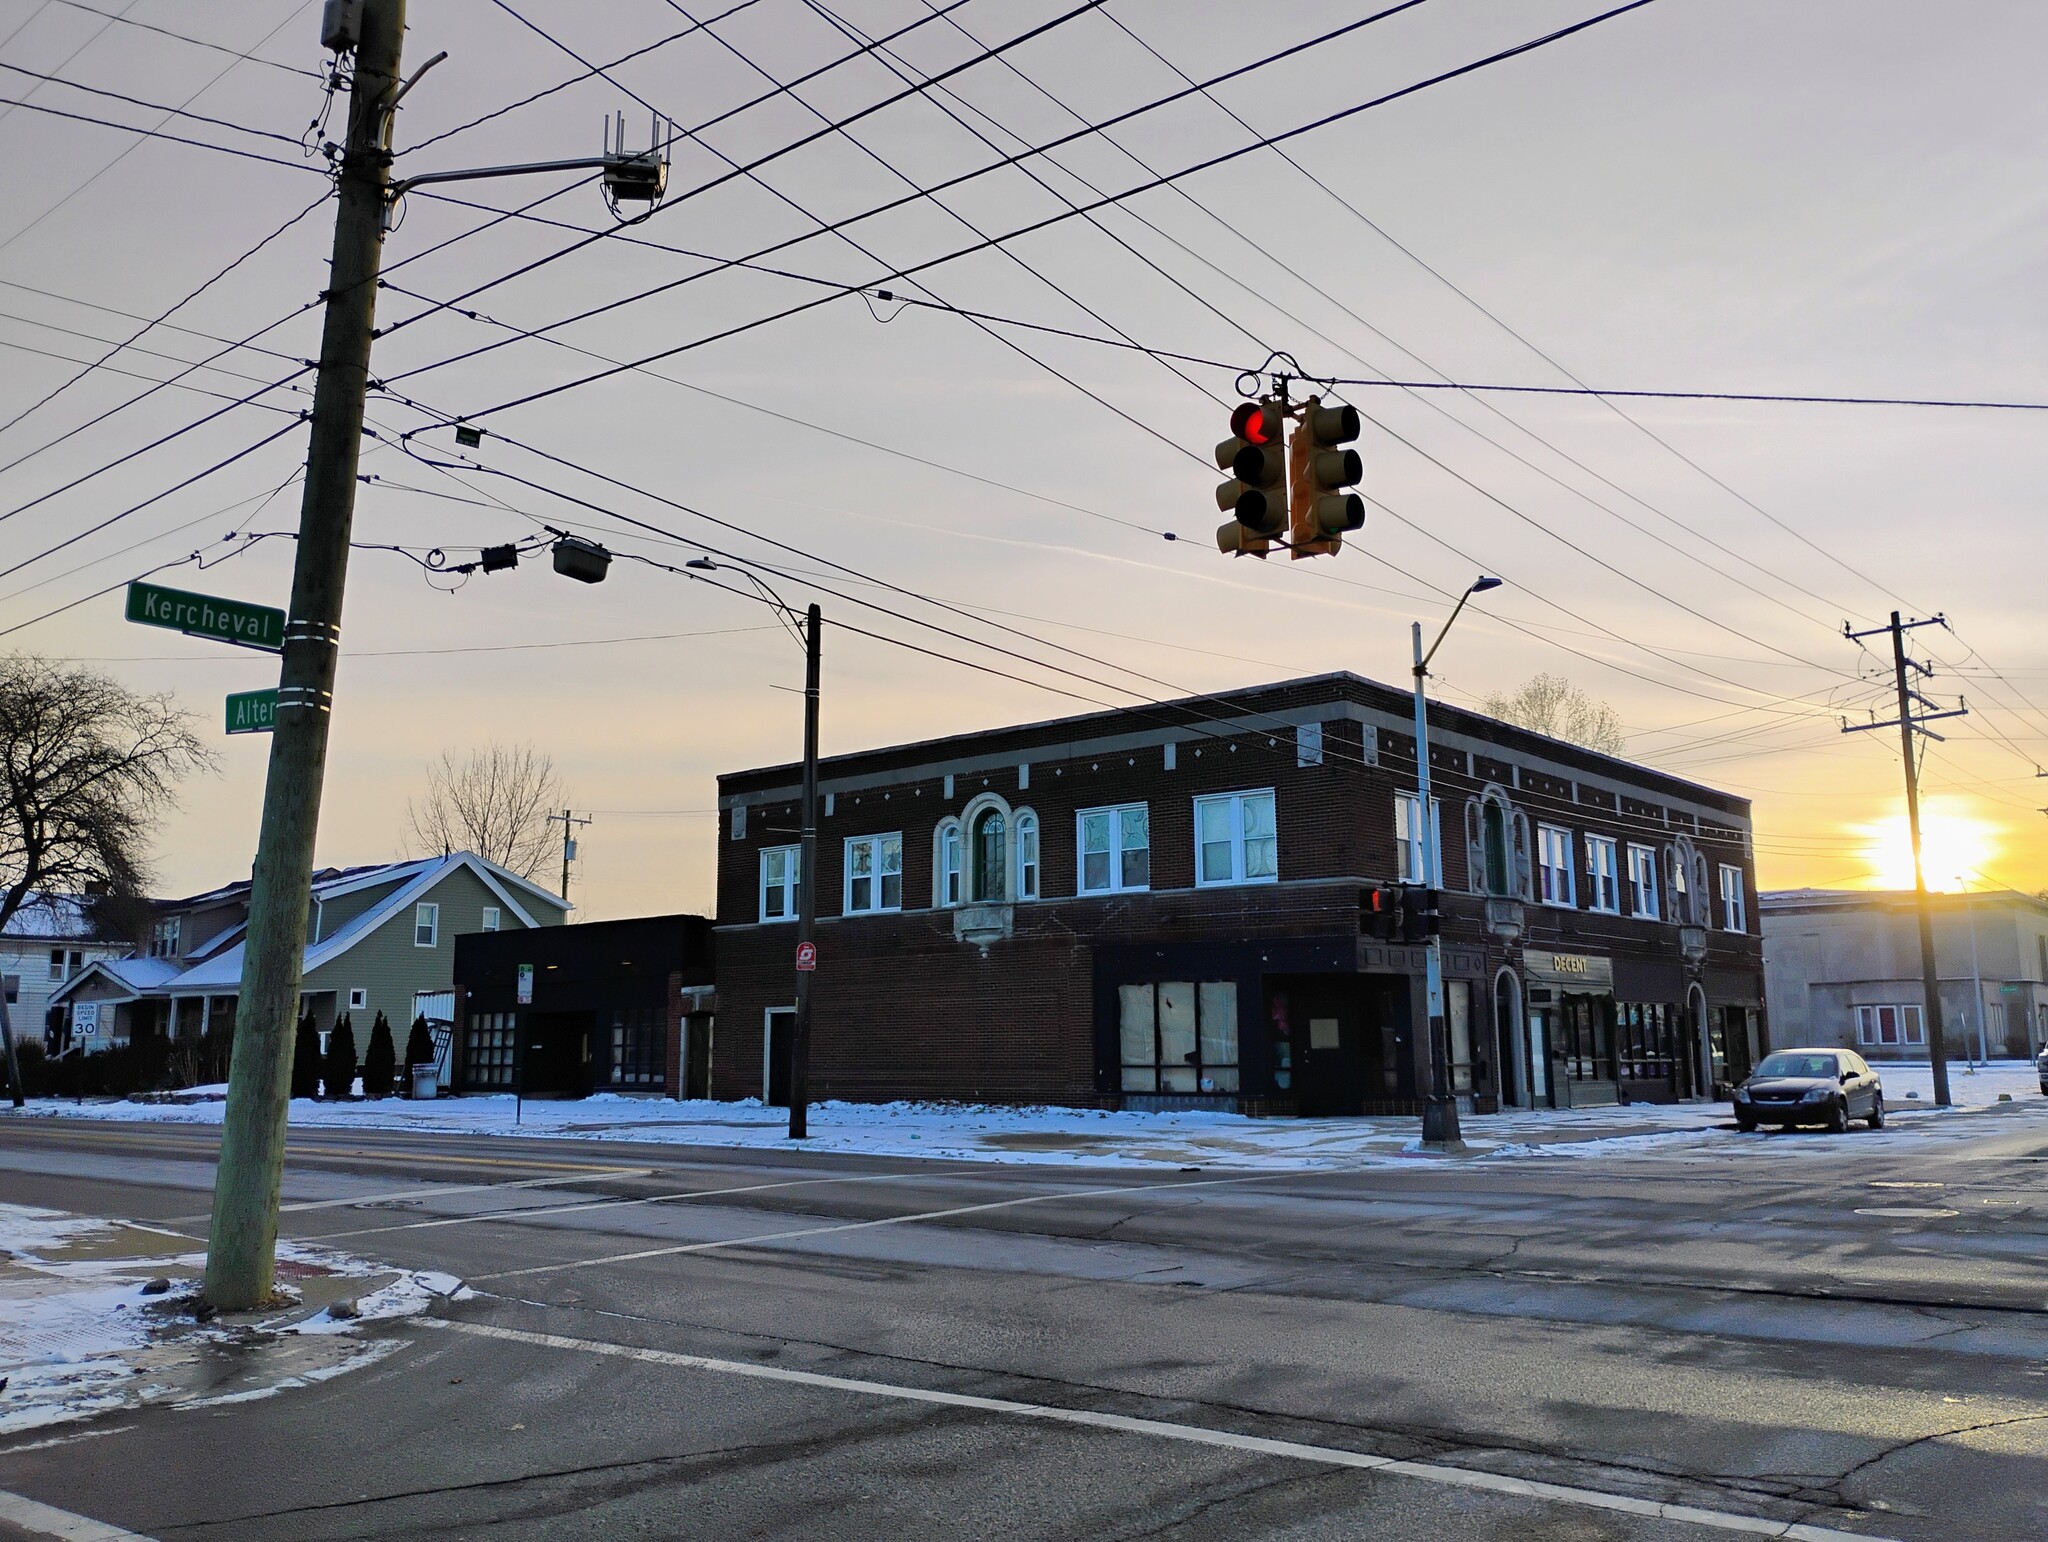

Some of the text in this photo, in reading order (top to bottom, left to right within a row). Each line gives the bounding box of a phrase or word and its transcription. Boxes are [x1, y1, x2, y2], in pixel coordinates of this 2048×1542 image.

[144, 592, 269, 638] Kercheval
[236, 701, 276, 725] Alter
[1553, 955, 1587, 973] DECENT
[74, 1023, 95, 1034] 30
